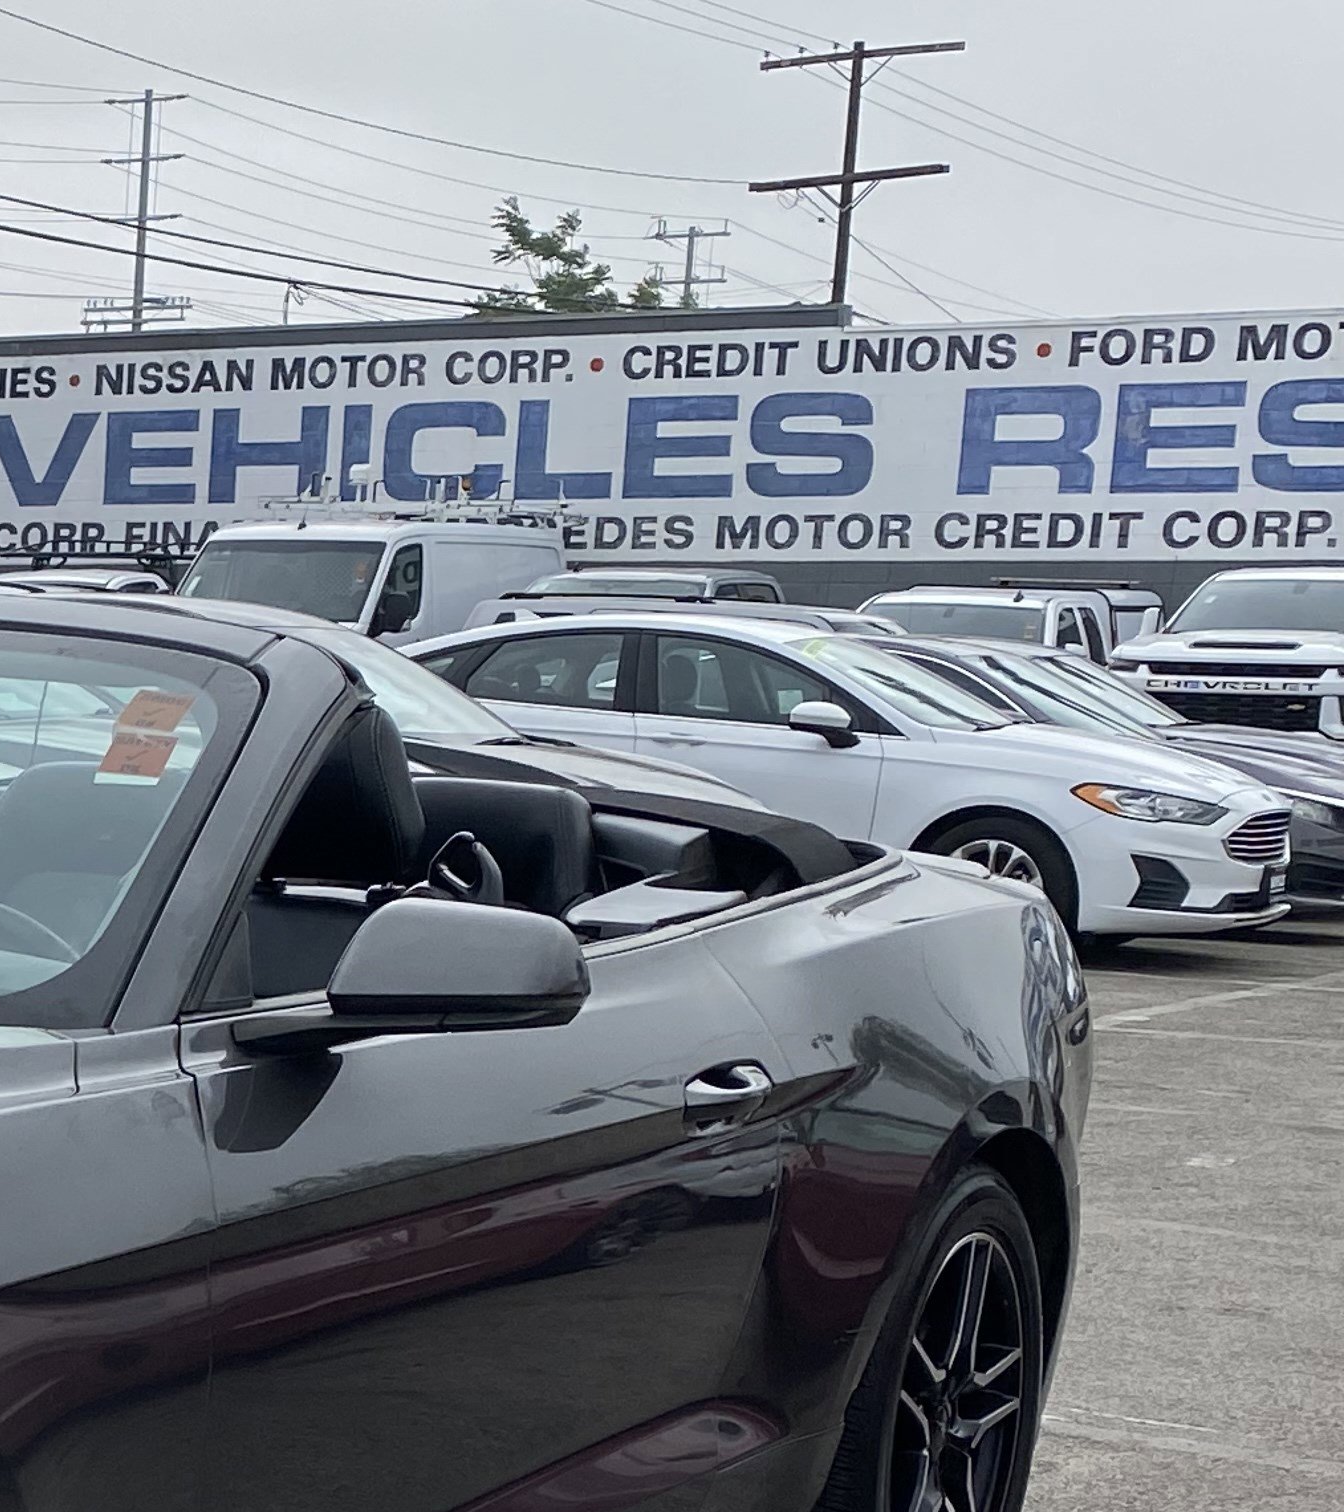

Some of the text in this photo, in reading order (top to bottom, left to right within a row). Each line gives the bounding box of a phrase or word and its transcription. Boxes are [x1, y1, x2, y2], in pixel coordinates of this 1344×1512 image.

[95, 359, 254, 396] NISSAN
[270, 353, 426, 390] MOTOR
[444, 349, 574, 385] CORP.
[622, 341, 799, 380] CREDIT
[817, 333, 1018, 375] UNIONS
[1068, 326, 1215, 368] FORD
[1236, 322, 1344, 361] MO
[717, 513, 912, 549] MOTOR
[934, 511, 1143, 549] CREDIT
[1162, 510, 1338, 549] CORP.
[1146, 678, 1320, 692] CHEVROLET
